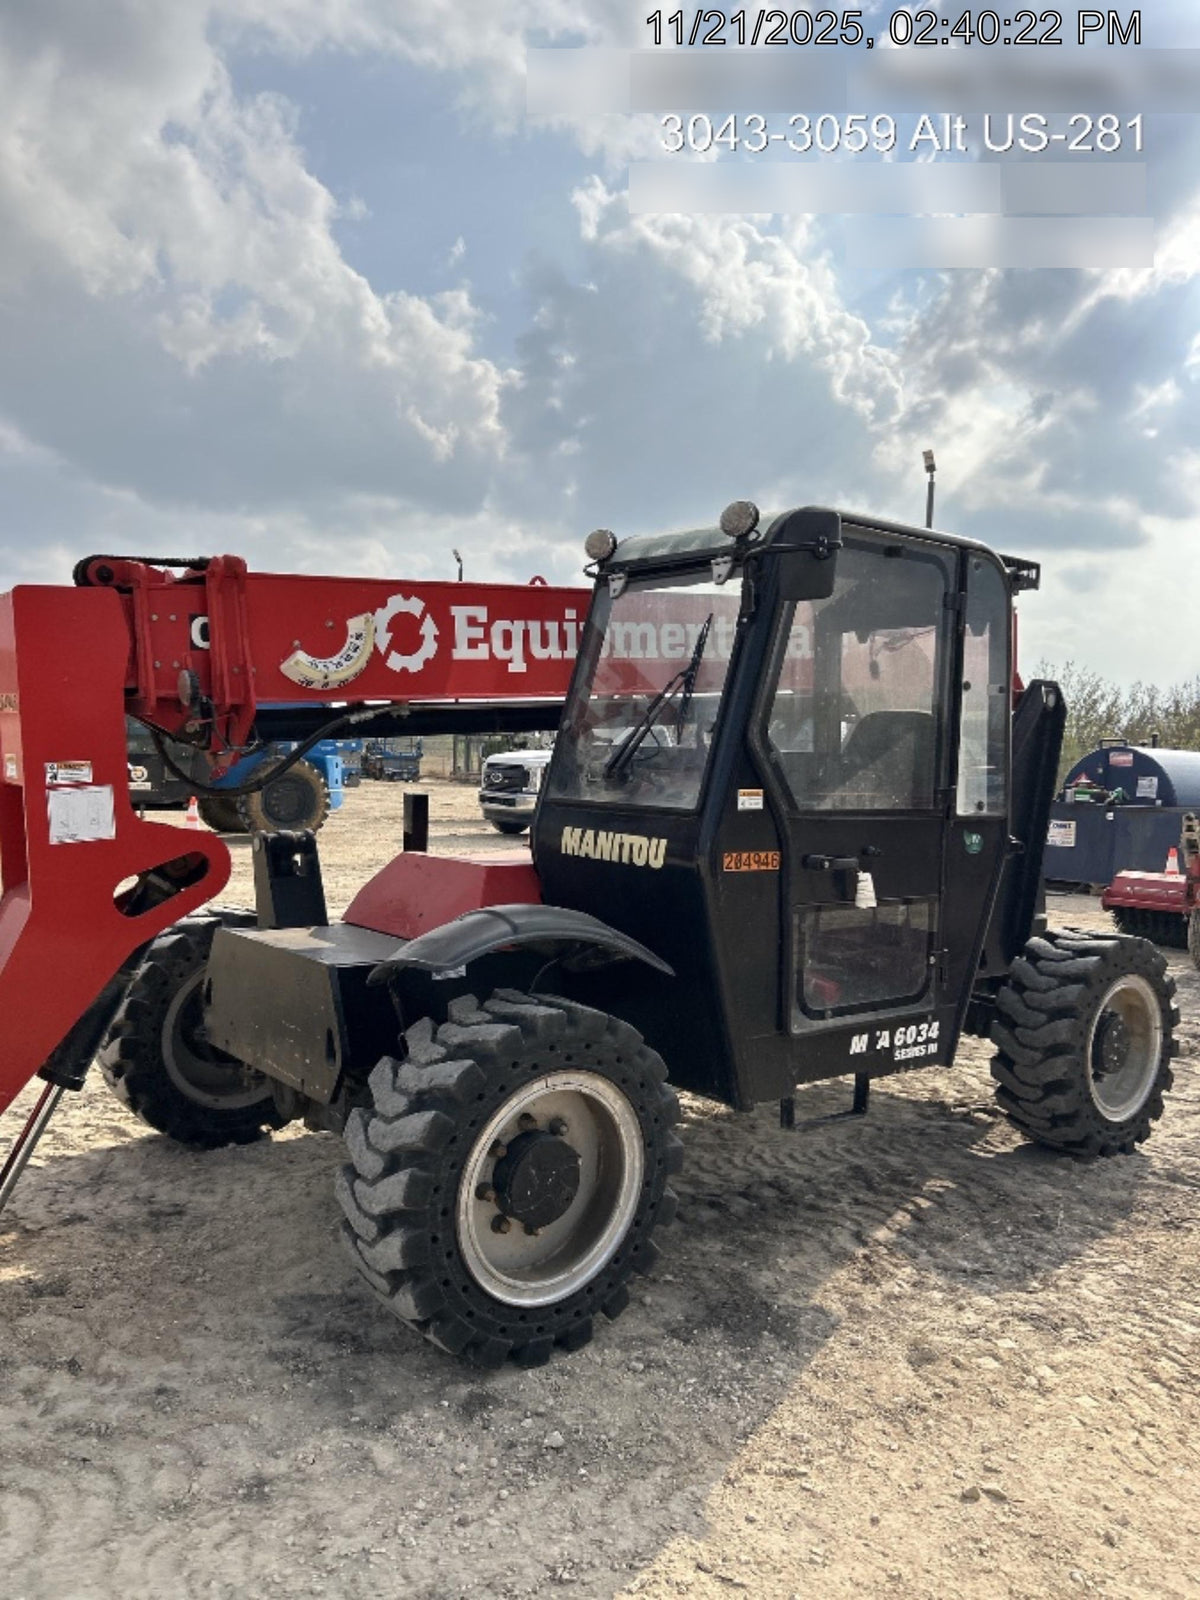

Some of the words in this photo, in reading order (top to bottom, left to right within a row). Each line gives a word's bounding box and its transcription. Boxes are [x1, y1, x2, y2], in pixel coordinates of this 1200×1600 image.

[561, 825, 668, 869] MANITOU
[849, 1029, 889, 1055] MA
[892, 1020, 940, 1046] 6034
